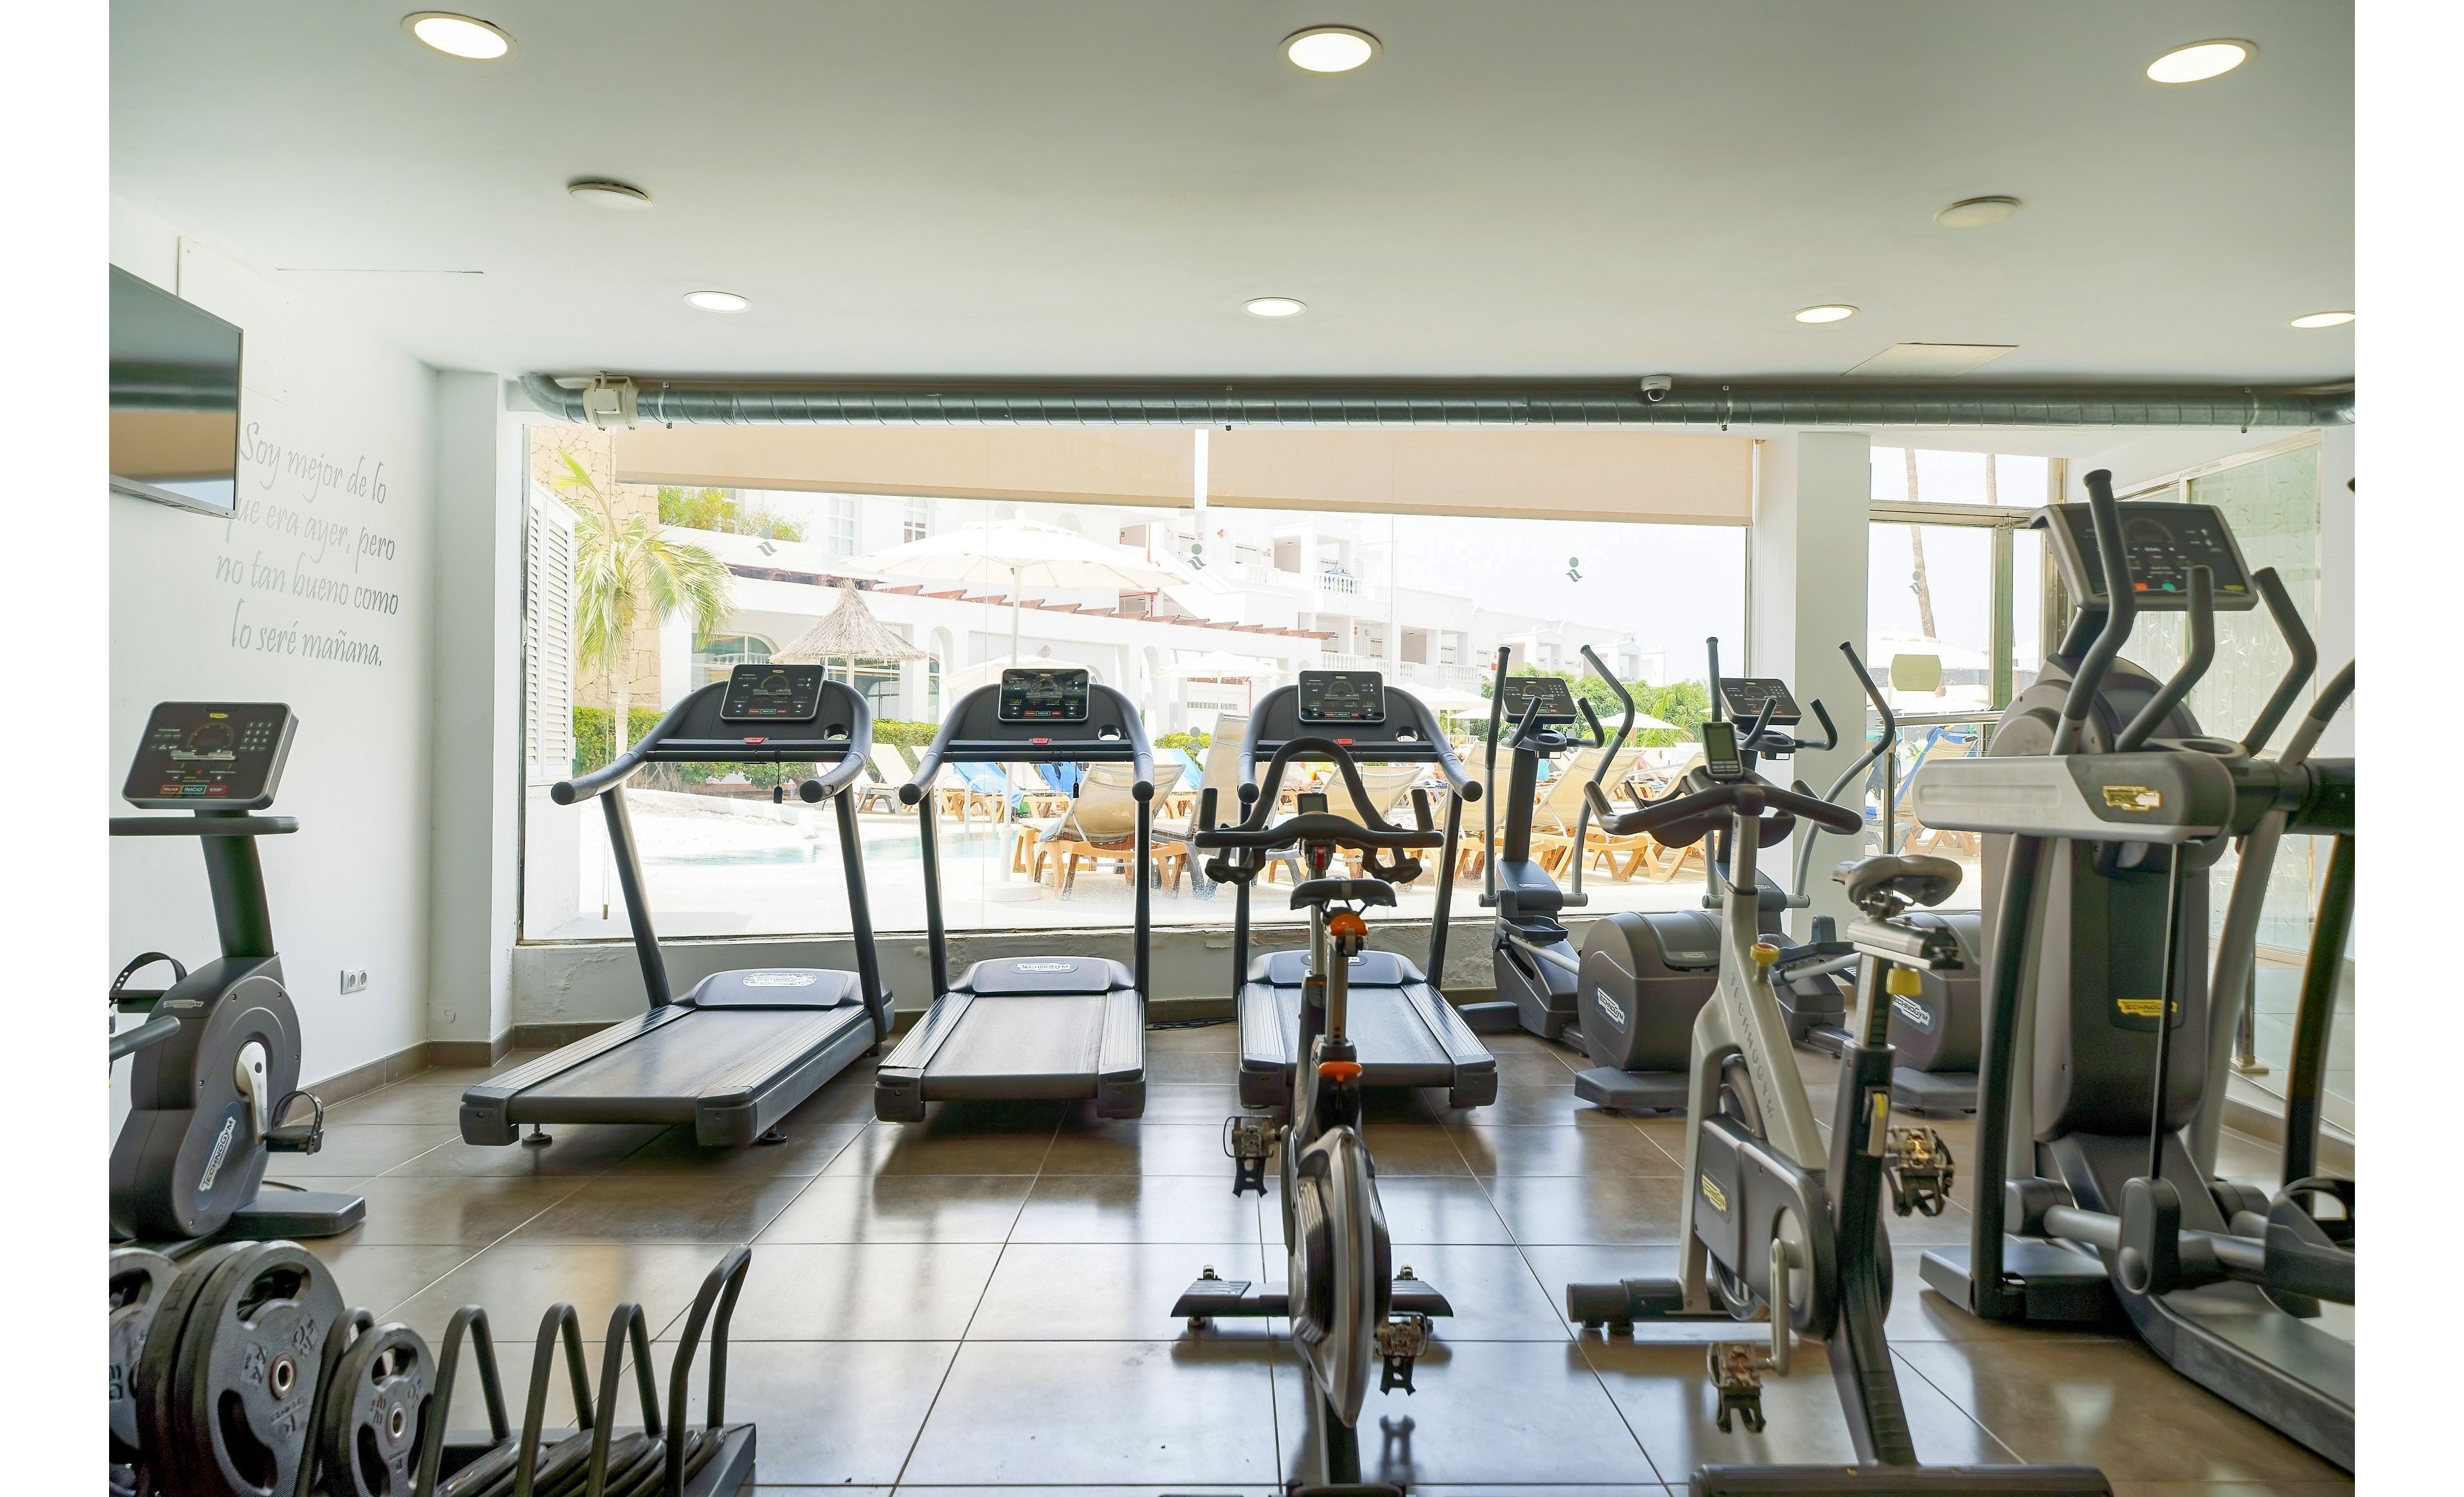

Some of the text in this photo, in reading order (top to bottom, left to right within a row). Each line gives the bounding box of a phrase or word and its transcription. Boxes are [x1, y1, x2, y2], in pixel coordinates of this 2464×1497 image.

[239, 422, 386, 504] Soy mejor de lo
[266, 504, 298, 536] era
[304, 515, 350, 564] ayer,
[355, 526, 395, 574] pero
[216, 551, 398, 615] no tan bueno como
[231, 598, 382, 667] lo seré mañana.
[1598, 990, 1624, 1022] TECHNOGYM
[1894, 995, 1929, 1021] ECHNOGYM
[201, 1119, 234, 1188] TECHNOGYM
